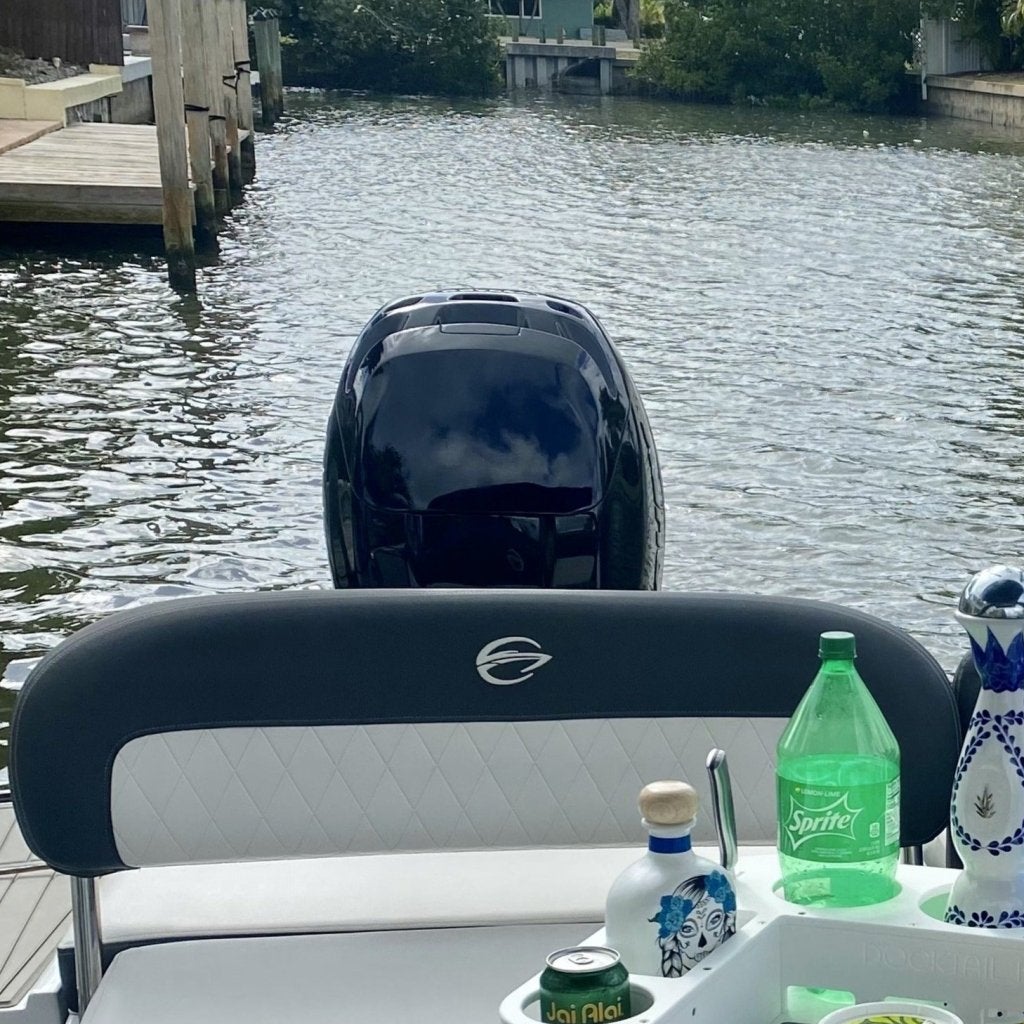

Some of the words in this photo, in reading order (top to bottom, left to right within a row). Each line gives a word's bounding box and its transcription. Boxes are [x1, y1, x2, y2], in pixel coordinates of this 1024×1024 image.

[789, 809, 851, 835] Sprite
[546, 1002, 576, 1024] Jai
[582, 997, 622, 1024] Alai
